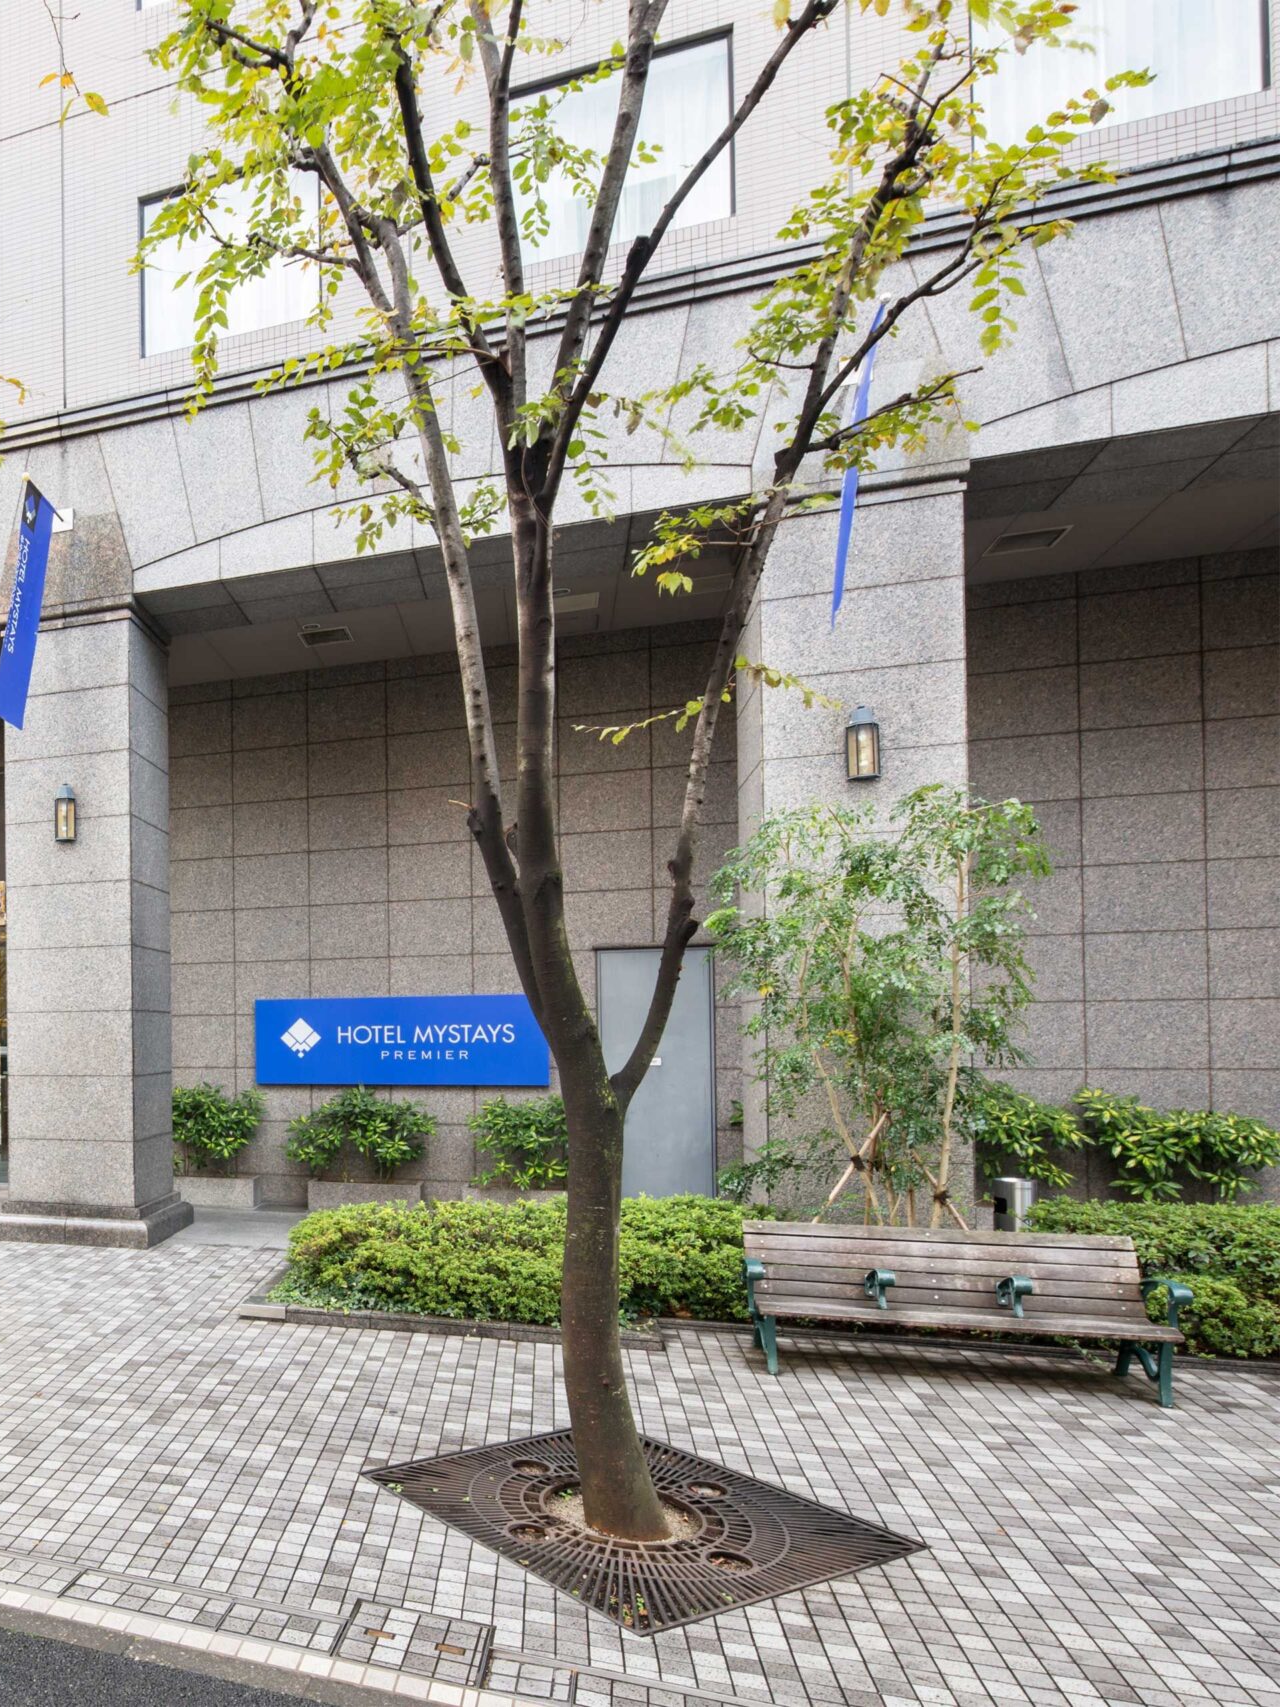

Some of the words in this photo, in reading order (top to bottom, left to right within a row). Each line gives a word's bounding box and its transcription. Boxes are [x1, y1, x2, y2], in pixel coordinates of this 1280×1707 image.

[18, 537, 31, 583] HOTEL
[7, 586, 23, 654] MYSTAYS
[337, 1025, 406, 1044] HOTEL
[413, 1024, 516, 1043] MYSTAYS
[380, 1050, 469, 1060] PREMIER
